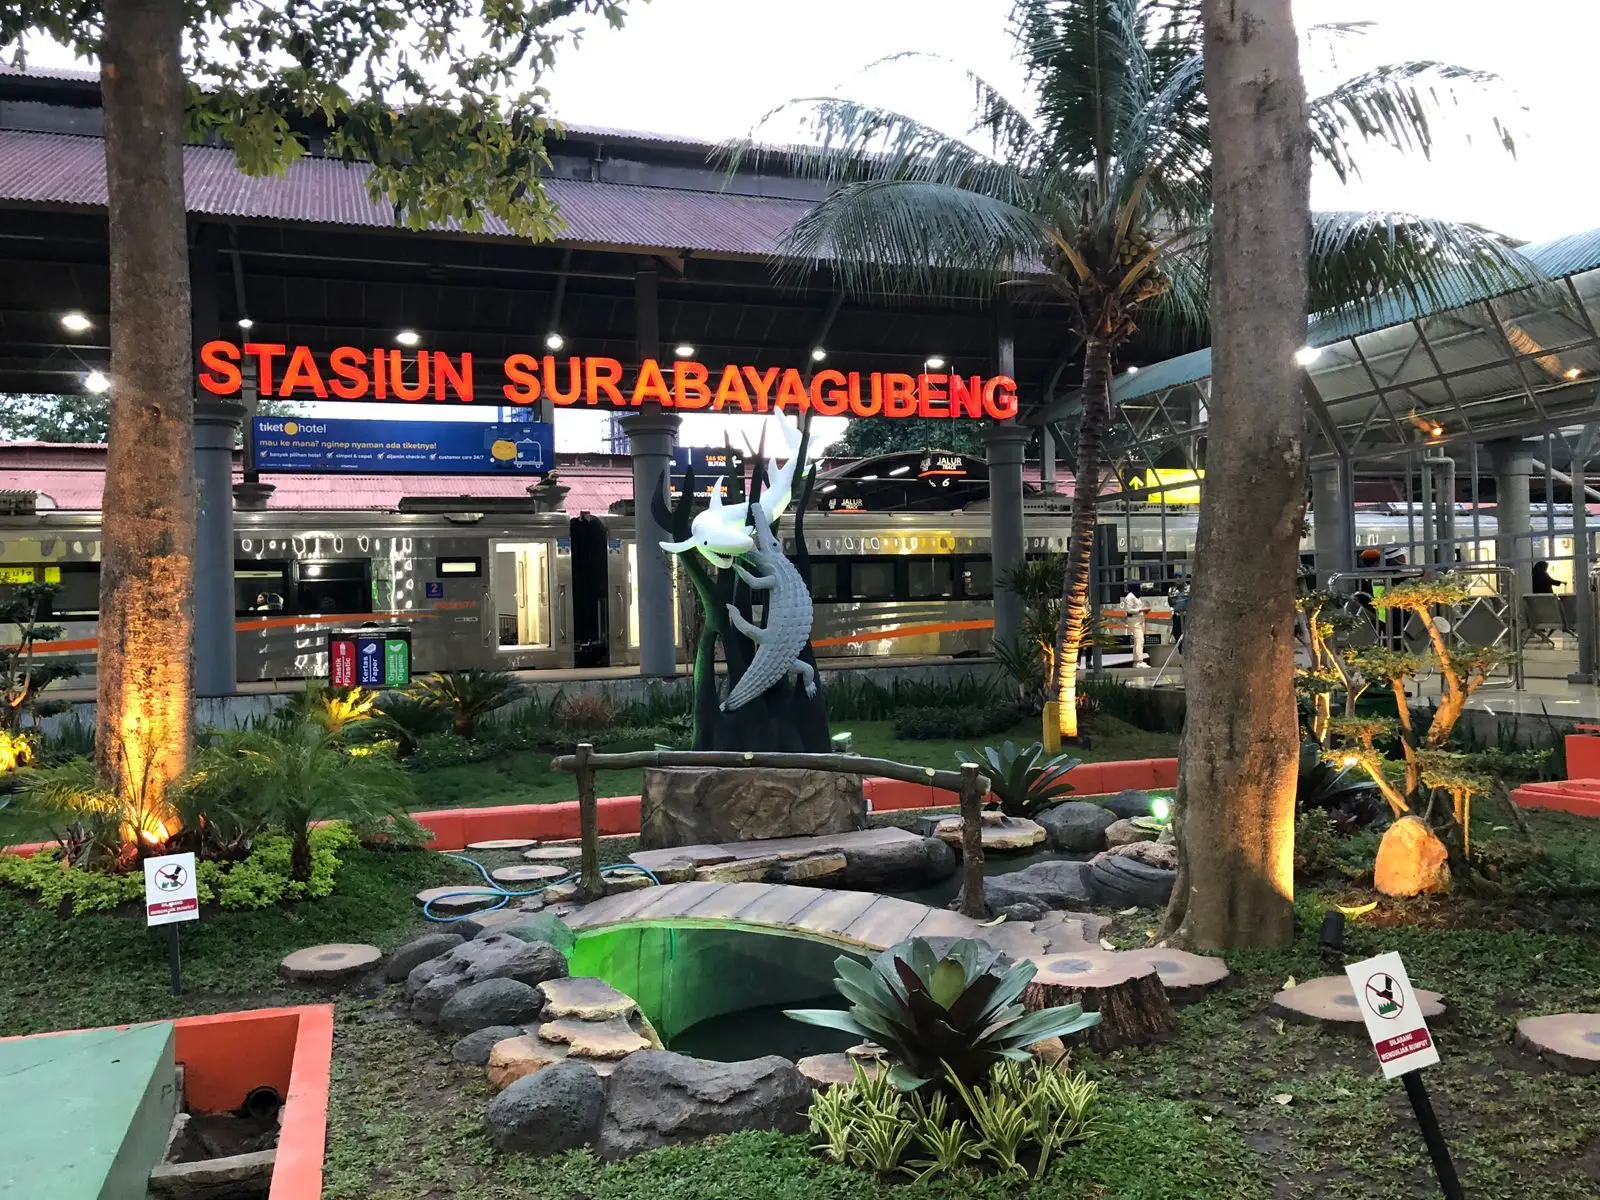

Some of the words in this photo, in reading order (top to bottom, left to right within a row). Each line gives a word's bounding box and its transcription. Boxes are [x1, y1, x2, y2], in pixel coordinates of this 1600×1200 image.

[199, 340, 474, 402] STASIUN
[259, 422, 284, 432] tiket
[298, 423, 327, 434] hotel
[321, 441, 349, 449] nginep
[351, 442, 384, 450] nyaman
[936, 457, 962, 466] JALUR
[942, 478, 950, 487] 6
[432, 584, 438, 592] 2
[1389, 1034, 1413, 1046] DILARANG
[1381, 1046, 1409, 1060] MENGINJAK
[1410, 1040, 1428, 1052] RUMPUT
